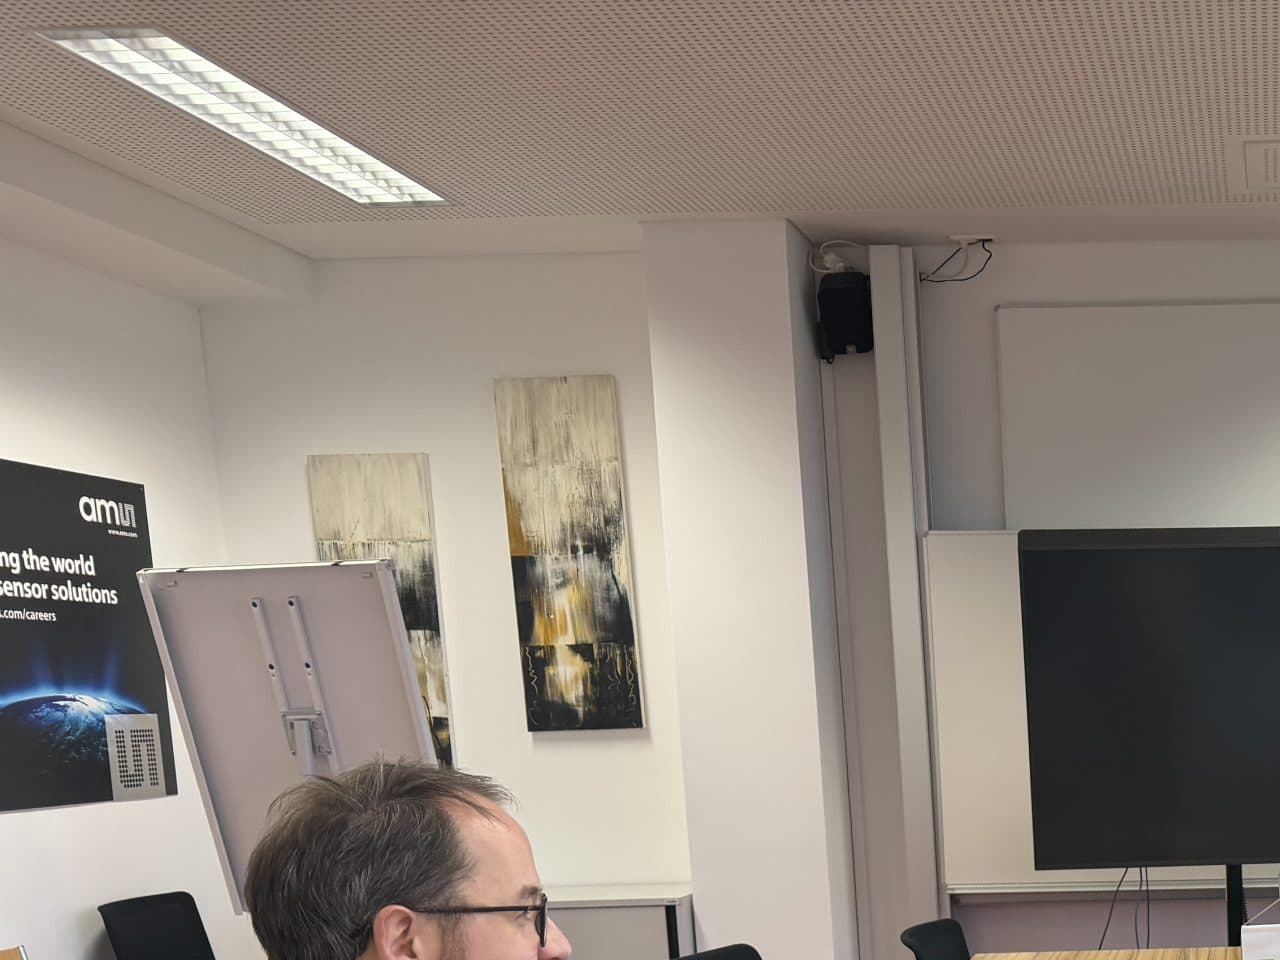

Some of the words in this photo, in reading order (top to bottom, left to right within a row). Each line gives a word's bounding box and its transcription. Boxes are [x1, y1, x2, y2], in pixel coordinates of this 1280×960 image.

[22, 548, 50, 572] the
[51, 554, 96, 576] world
[51, 580, 118, 605] solutions
